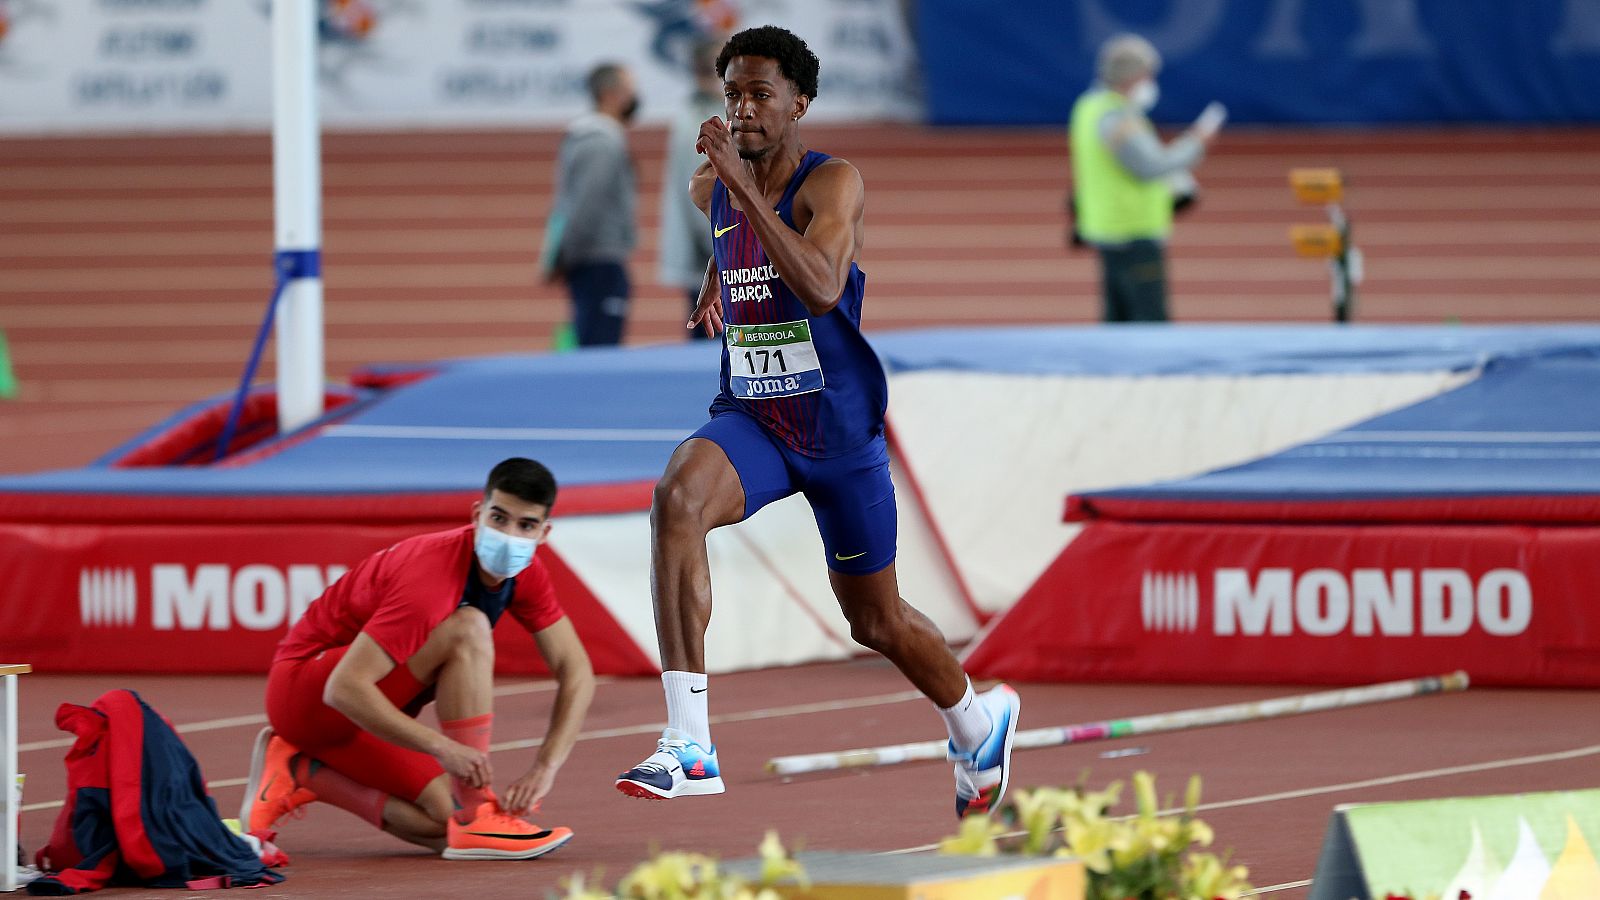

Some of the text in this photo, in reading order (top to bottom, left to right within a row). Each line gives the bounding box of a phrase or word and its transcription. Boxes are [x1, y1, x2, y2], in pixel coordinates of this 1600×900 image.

[731, 284, 772, 302] BARÇA
[745, 330, 795, 342] IBERDROLA
[745, 349, 787, 374] 171
[1213, 568, 1532, 637] MONDO
